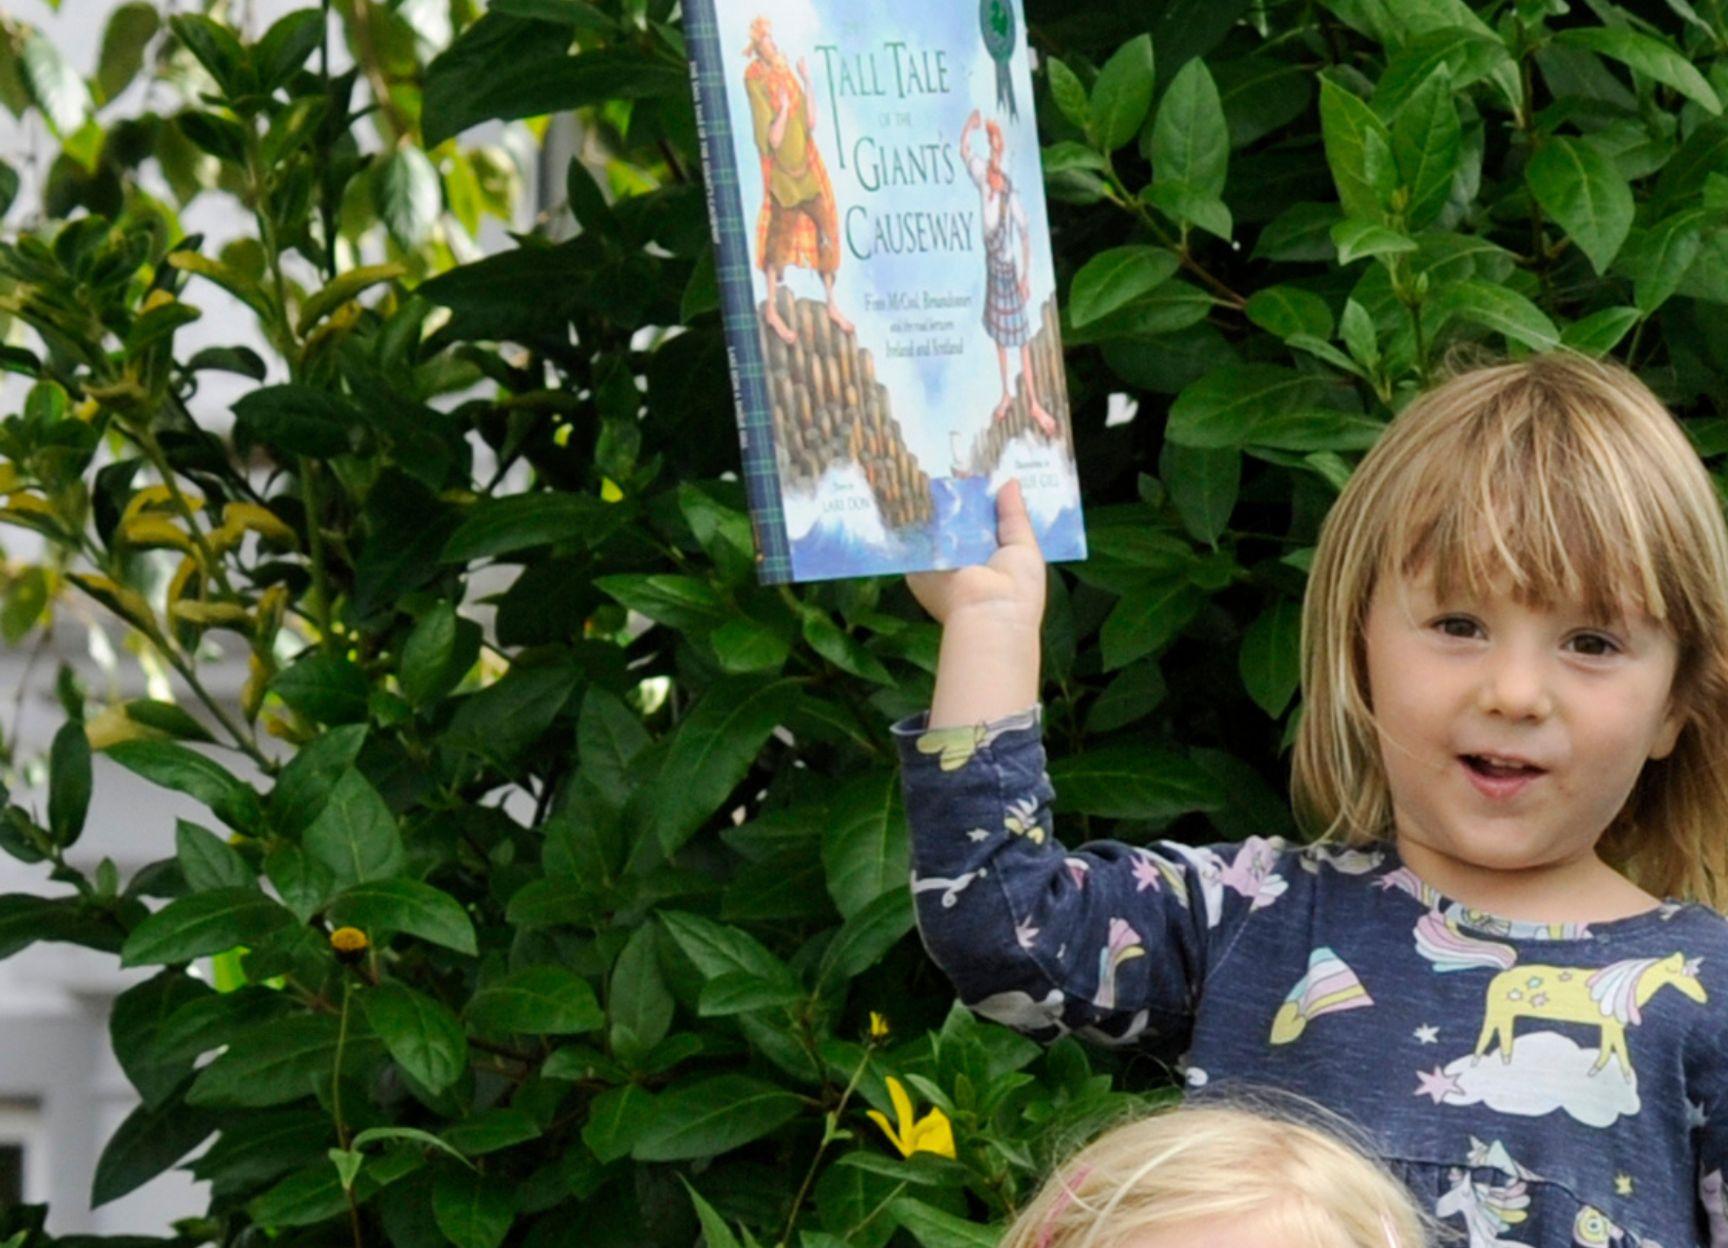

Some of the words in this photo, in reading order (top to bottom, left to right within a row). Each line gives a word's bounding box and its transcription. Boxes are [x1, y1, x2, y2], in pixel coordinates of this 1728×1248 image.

[815, 44, 886, 170] TALL
[884, 42, 951, 99] TALE
[854, 130, 956, 193] GIANT'S
[845, 205, 974, 261] CAUSEWAY
